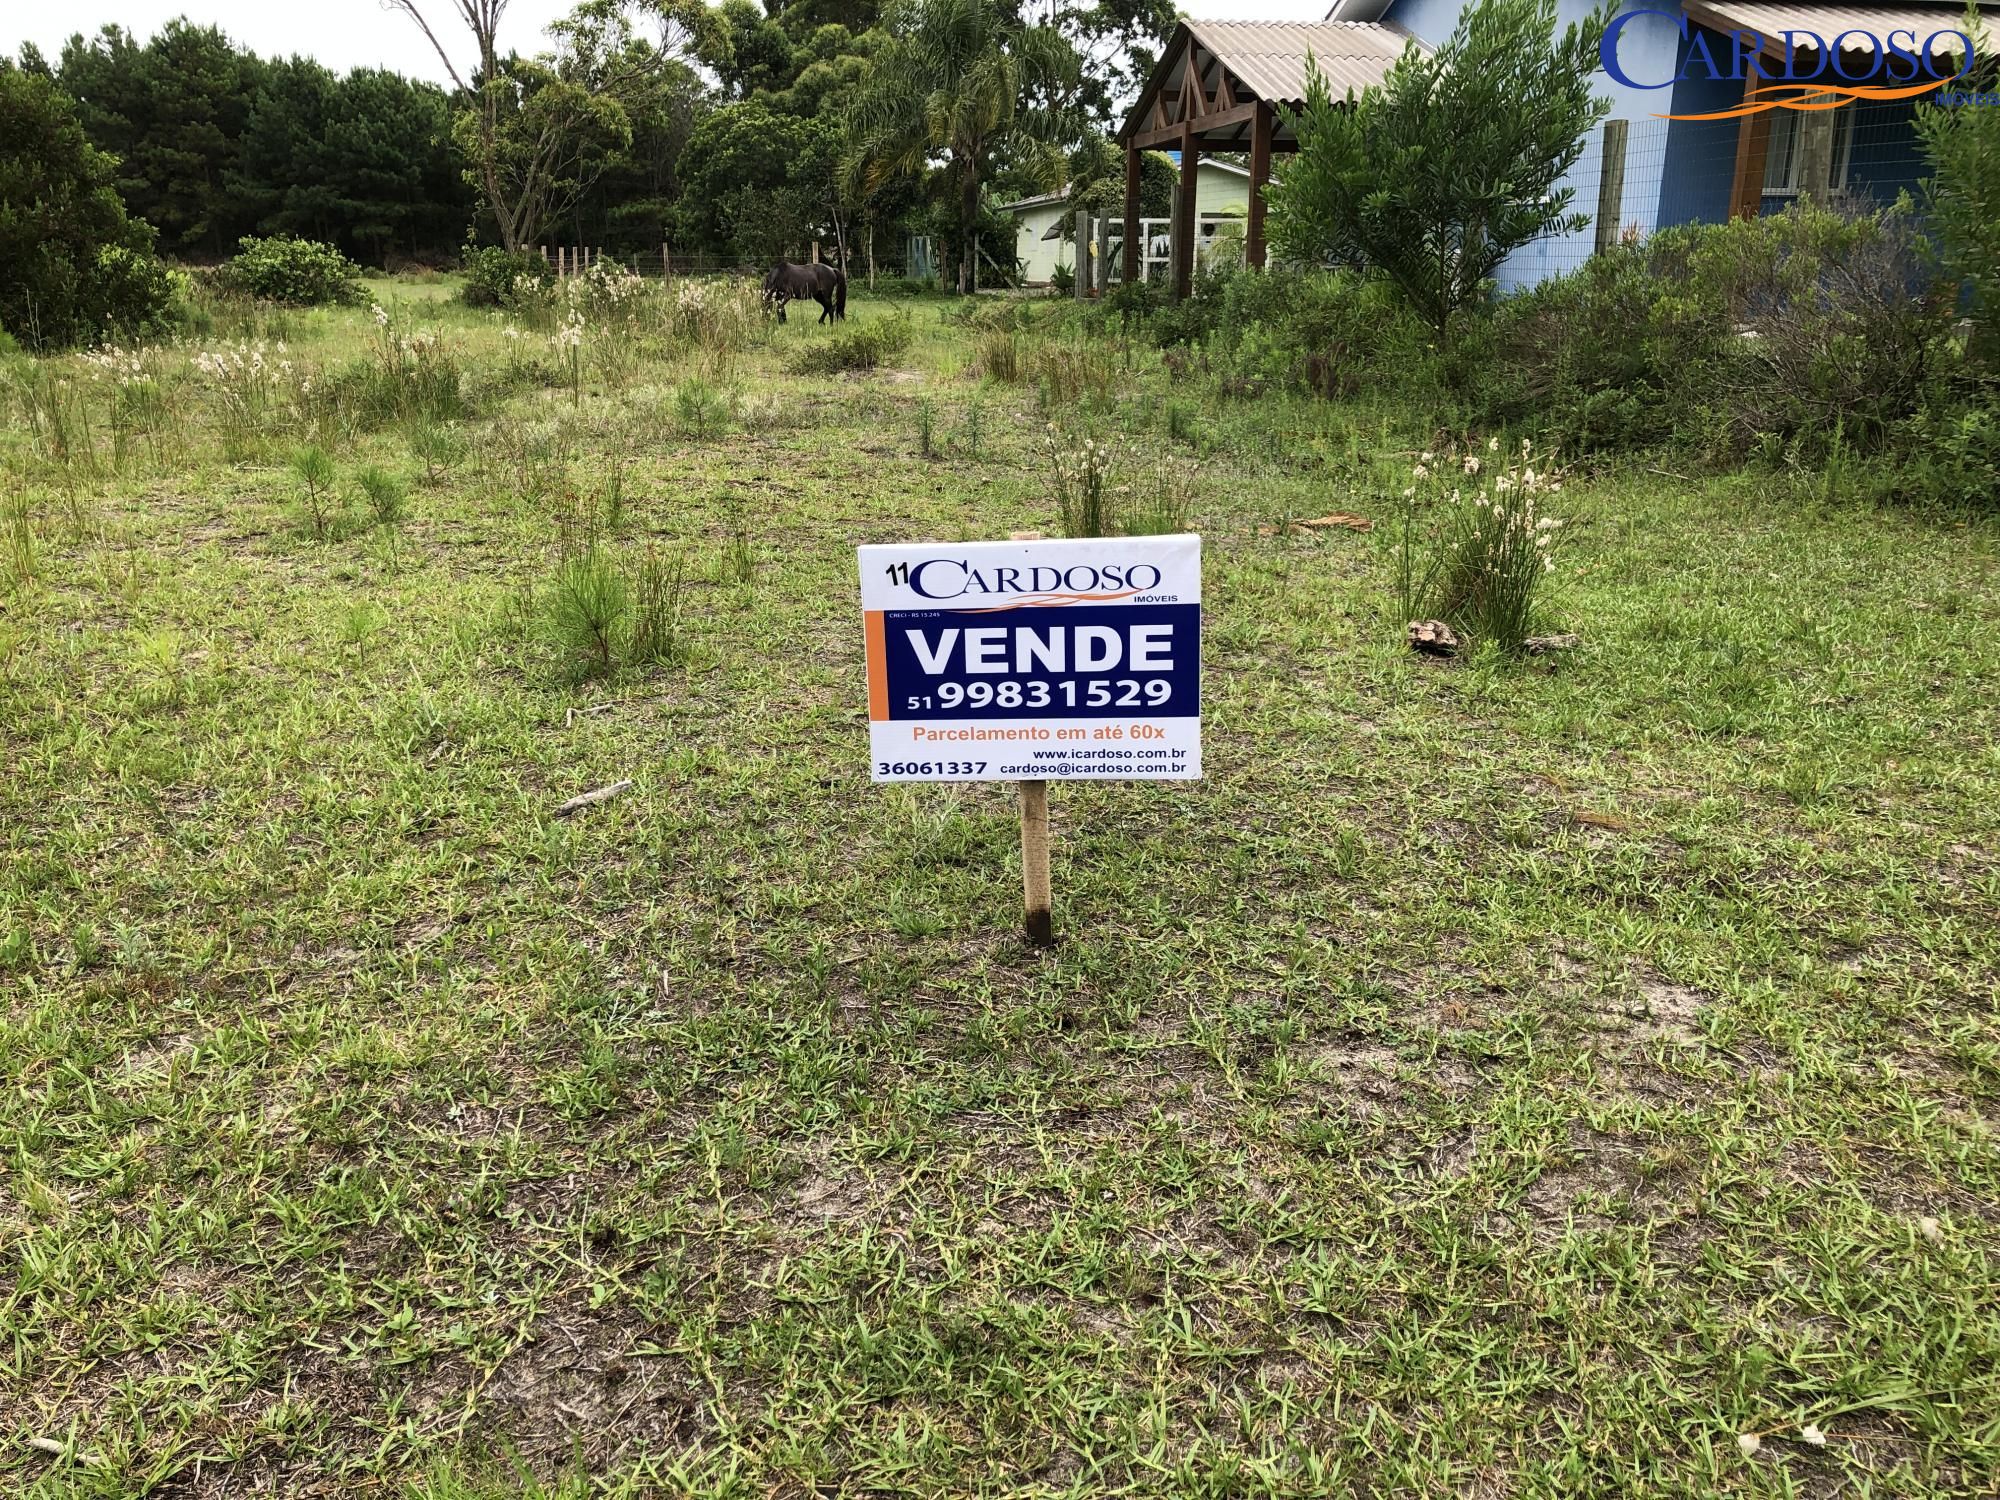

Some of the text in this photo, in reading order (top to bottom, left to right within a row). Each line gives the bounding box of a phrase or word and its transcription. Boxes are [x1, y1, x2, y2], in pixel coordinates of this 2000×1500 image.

[886, 562, 909, 586] 11
[909, 559, 1161, 599] CARDOSO
[1134, 594, 1178, 603] IMÓVEIS
[905, 624, 1174, 675] VENDE
[907, 679, 1172, 709] 51 99831529
[913, 725, 1166, 741] Parcelamento em até 60x
[1033, 748, 1187, 760] www.icardoso.com.br
[878, 762, 988, 775] 36061337
[1000, 762, 1187, 776] cardoso@icardoso.com.br
